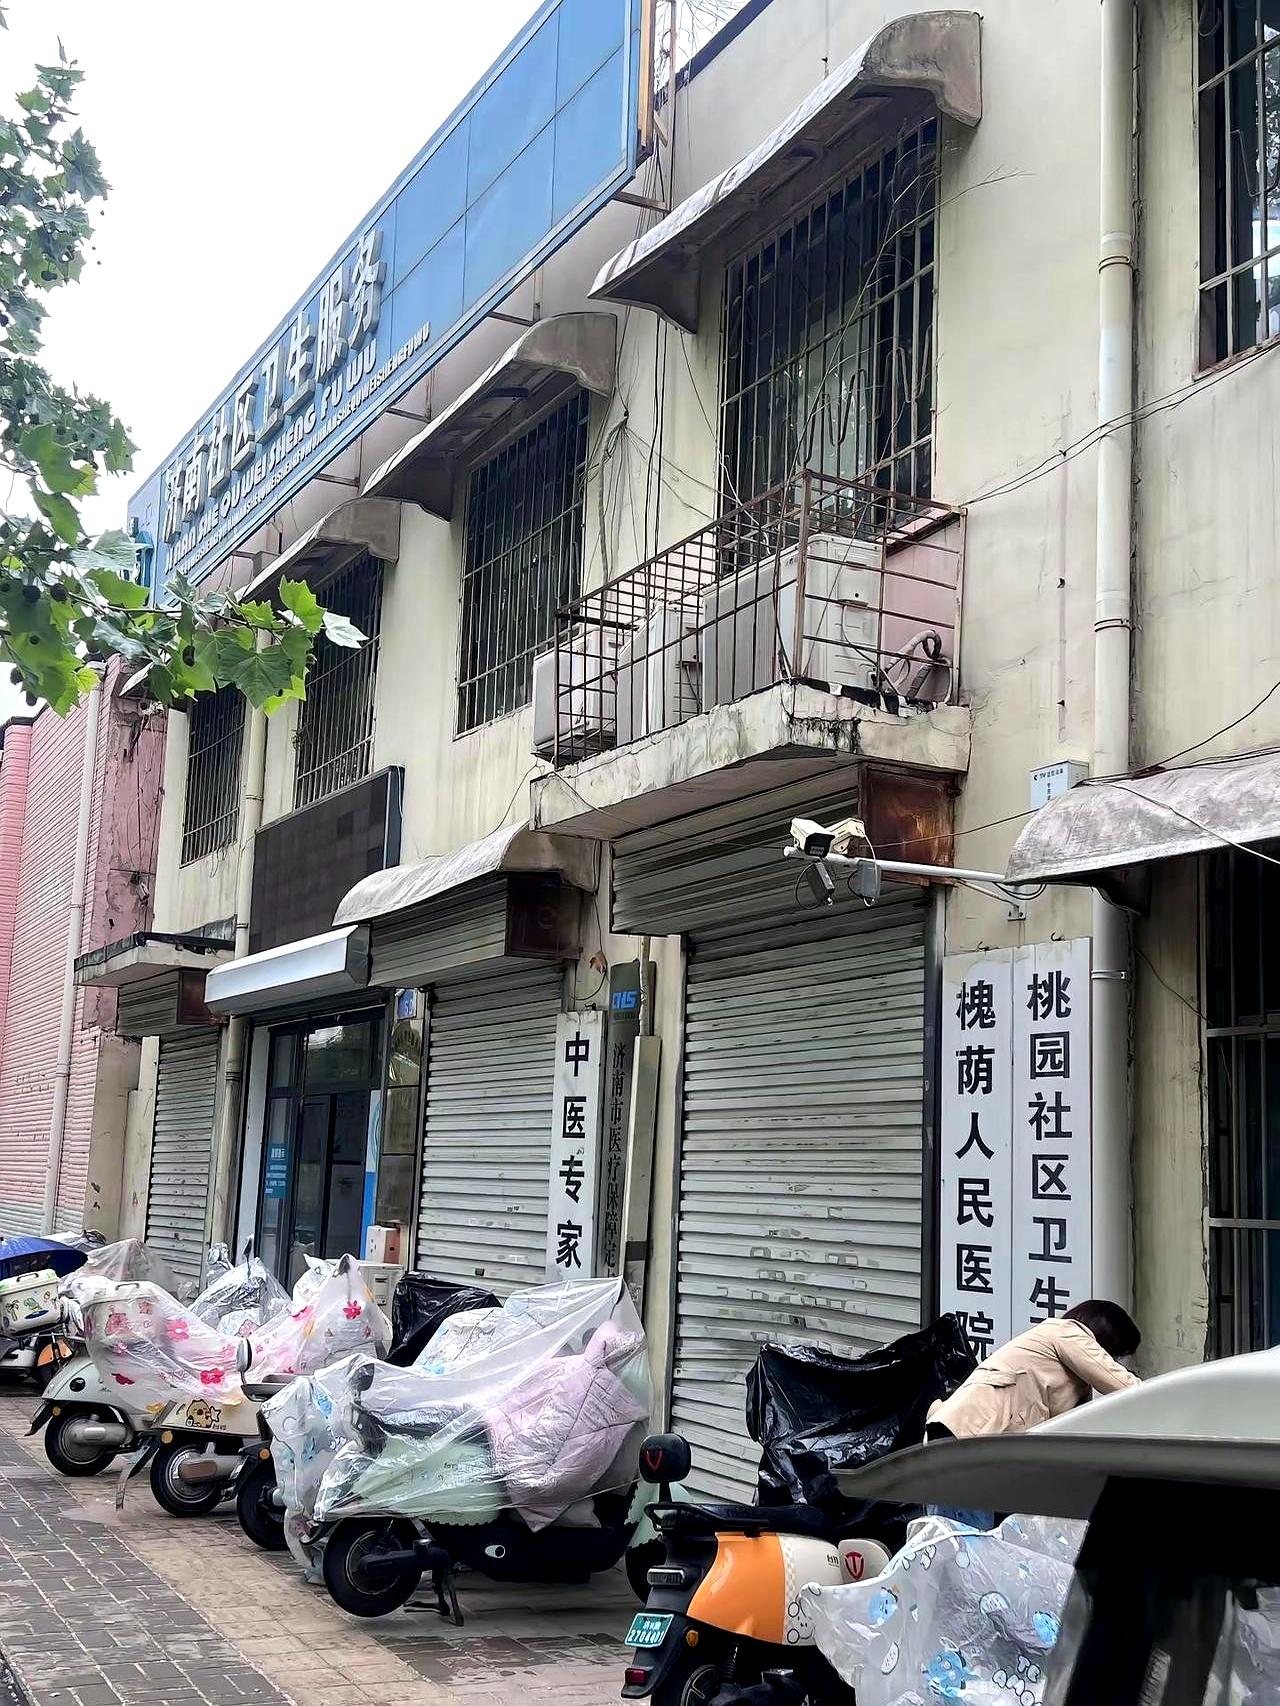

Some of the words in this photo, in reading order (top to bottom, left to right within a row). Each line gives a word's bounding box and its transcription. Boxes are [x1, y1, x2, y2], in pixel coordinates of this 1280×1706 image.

[164, 228, 385, 543] 济南社区卫生服务
[555, 1031, 590, 1269] 中医专家
[954, 979, 997, 1363] 槐荫人民医院
[1026, 969, 1073, 1323] 桃园社区卫生
